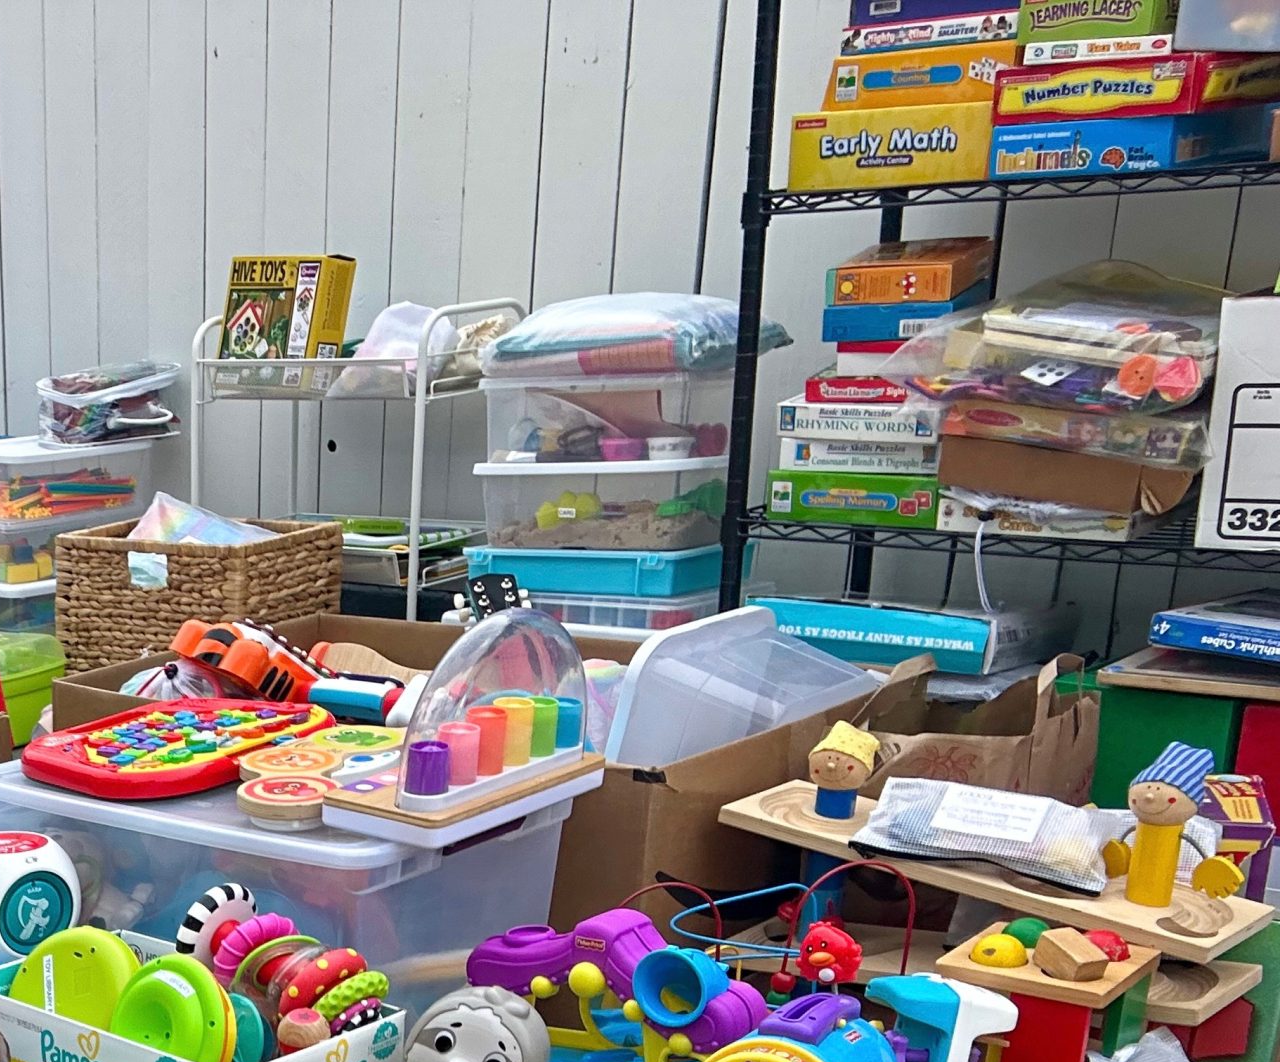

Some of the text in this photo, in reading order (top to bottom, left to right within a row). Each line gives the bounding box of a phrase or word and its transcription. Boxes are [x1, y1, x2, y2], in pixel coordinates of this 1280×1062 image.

[1030, 0, 1142, 31] LEARNING LACERS
[938, 26, 978, 38] SMARTER!
[1024, 80, 1154, 104] Number Puzzles
[821, 127, 957, 158] Early Math
[996, 134, 1091, 174] Inchimals
[1128, 147, 1144, 155] Fat
[1128, 153, 1154, 161] Brain
[860, 156, 910, 167] Activity Center
[232, 261, 258, 281] HIVE
[260, 260, 287, 282] TOYS
[886, 387, 905, 397] Sight
[819, 408, 892, 417] Basic Skills Puzzles
[796, 419, 915, 433] RHYMING WORDS
[827, 444, 906, 453] Basic Skills Puzzles
[811, 456, 849, 467] Consonant
[851, 457, 875, 467] Blends
[886, 457, 919, 469] Digraphs
[1152, 621, 1170, 634] 4+
[778, 623, 974, 651] WHACK AS MANY FROGS AS YOU
[1201, 635, 1280, 656] athLink Cubes
